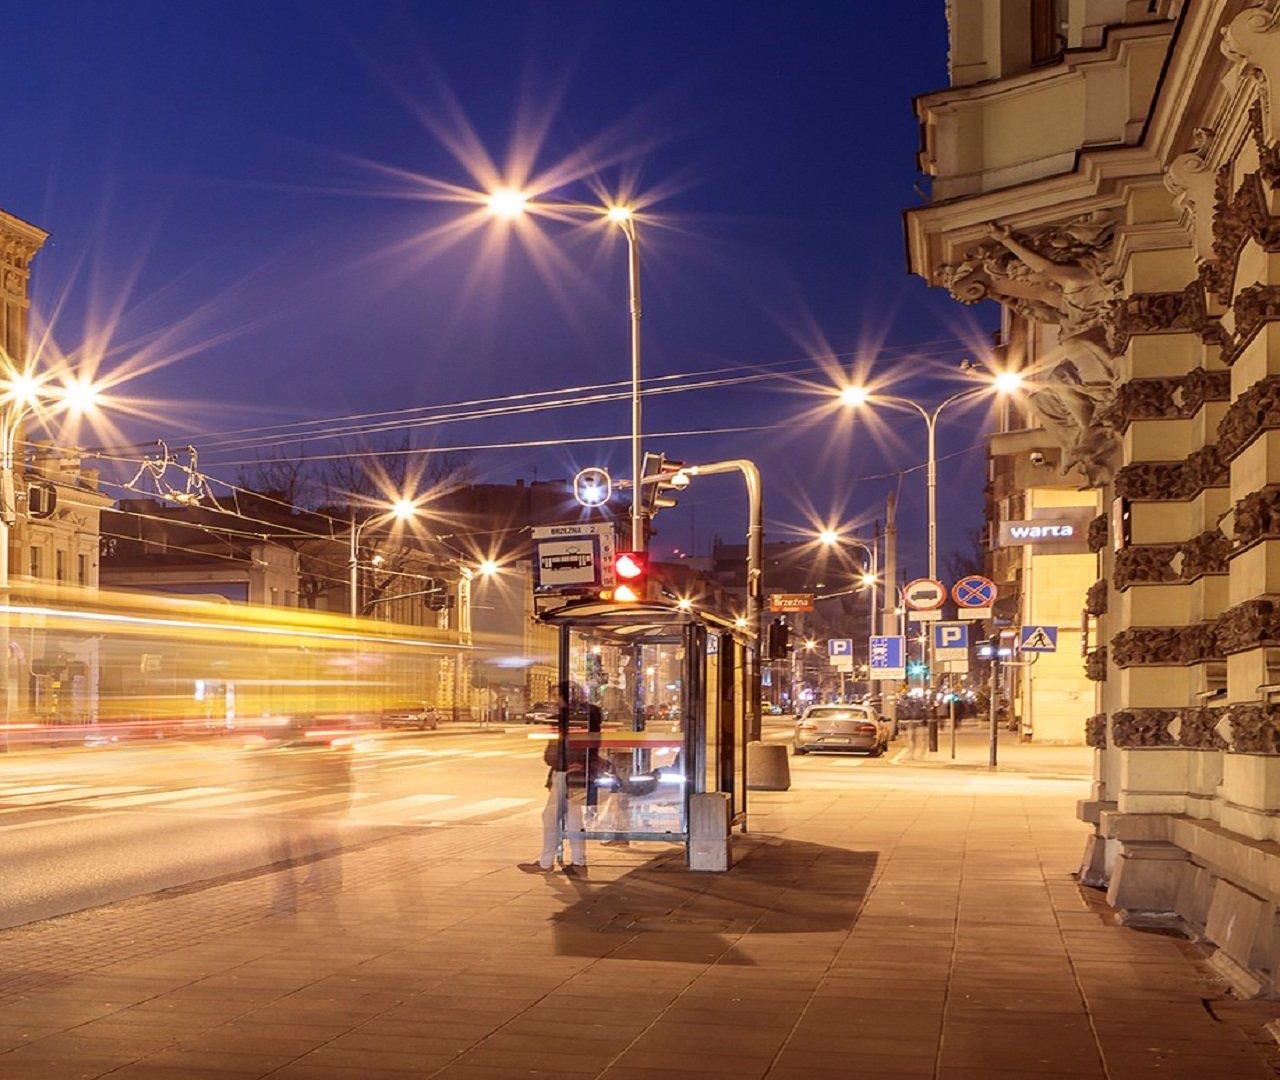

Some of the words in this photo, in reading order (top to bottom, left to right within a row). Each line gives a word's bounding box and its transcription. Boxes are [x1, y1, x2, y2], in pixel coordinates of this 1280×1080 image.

[1010, 525, 1073, 539] warta
[942, 627, 961, 646] P
[833, 641, 846, 654] P
